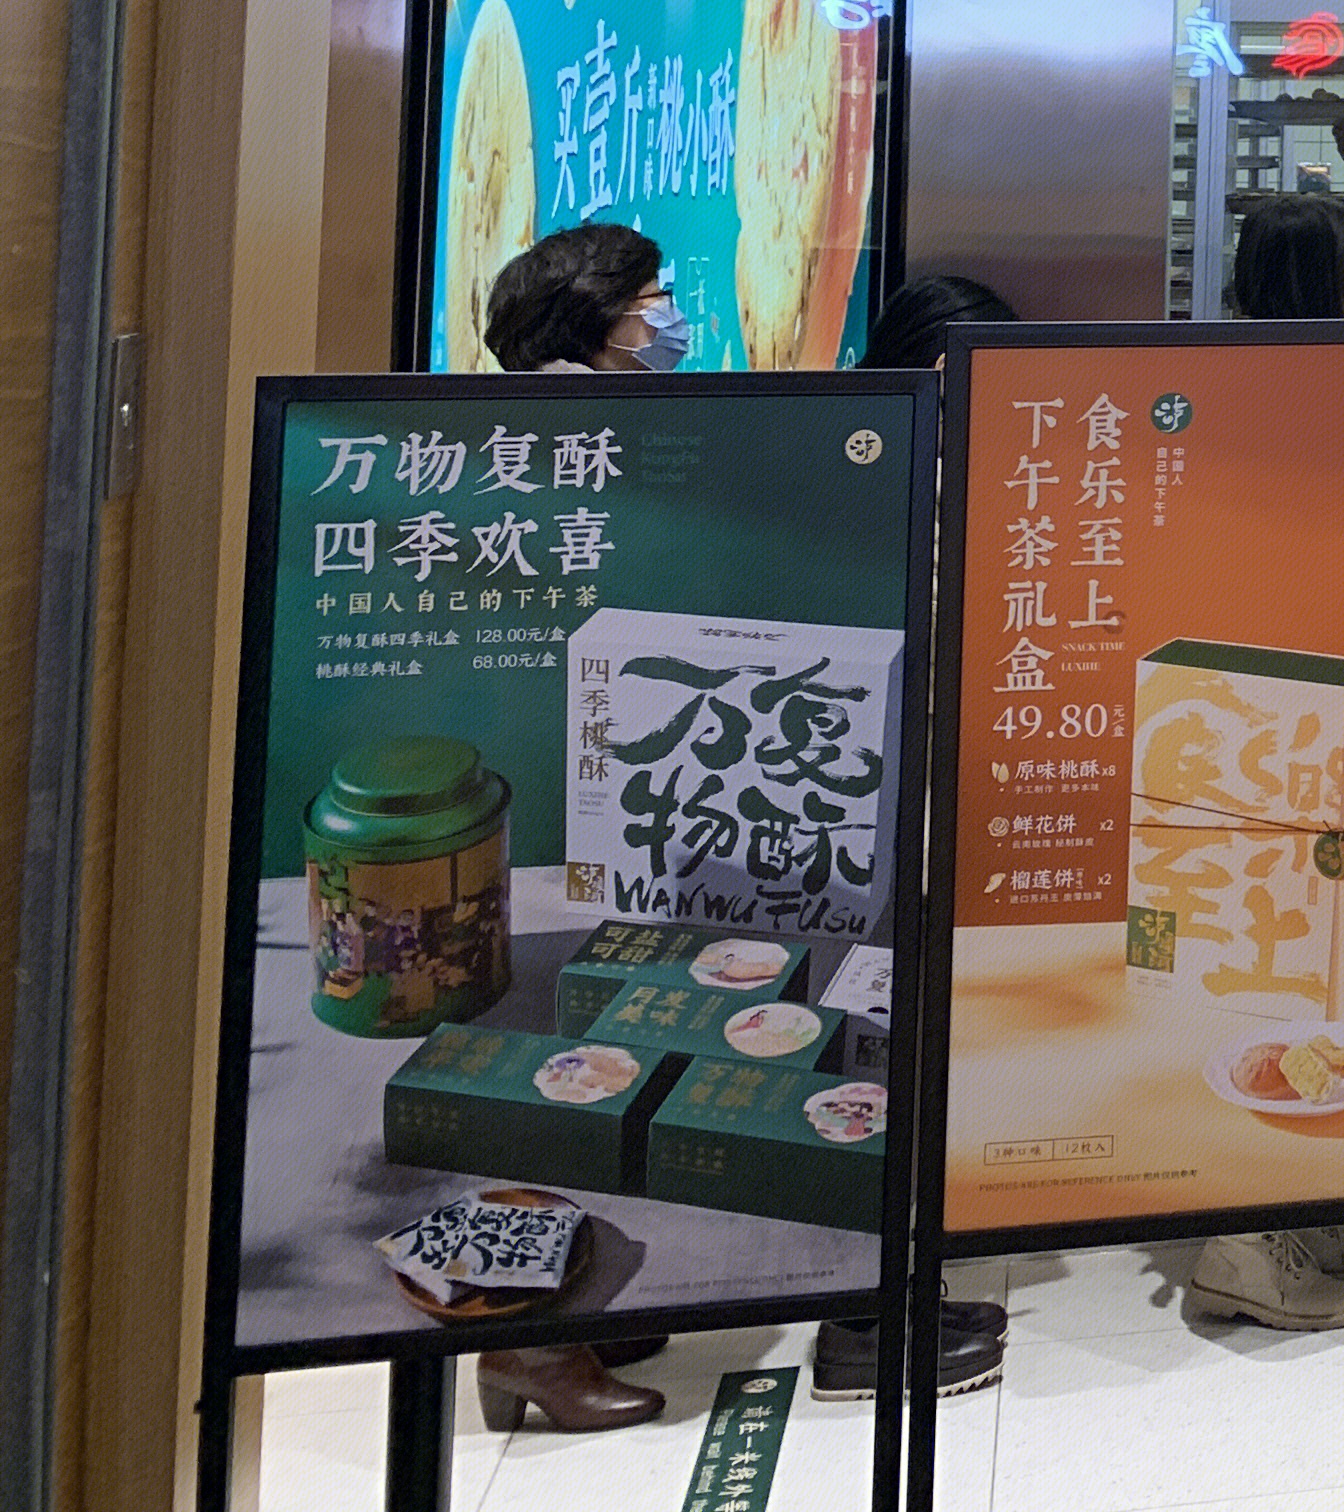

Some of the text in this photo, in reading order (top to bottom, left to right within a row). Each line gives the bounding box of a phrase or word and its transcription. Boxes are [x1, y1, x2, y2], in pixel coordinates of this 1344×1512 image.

[310, 426, 623, 497] 万物复酥
[1068, 392, 1131, 631] 食乐至上
[314, 508, 616, 581] 四季欢喜
[992, 397, 1065, 693] 下午茶礼盒
[316, 585, 598, 616] 中国人自己的下午茶
[578, 657, 610, 782] 四季桃酥
[992, 703, 1108, 739] 49.80
[1015, 759, 1100, 780] 原味桃酥
[1012, 814, 1077, 835] 鲜花饼
[1010, 868, 1074, 890] 榴莲饼
